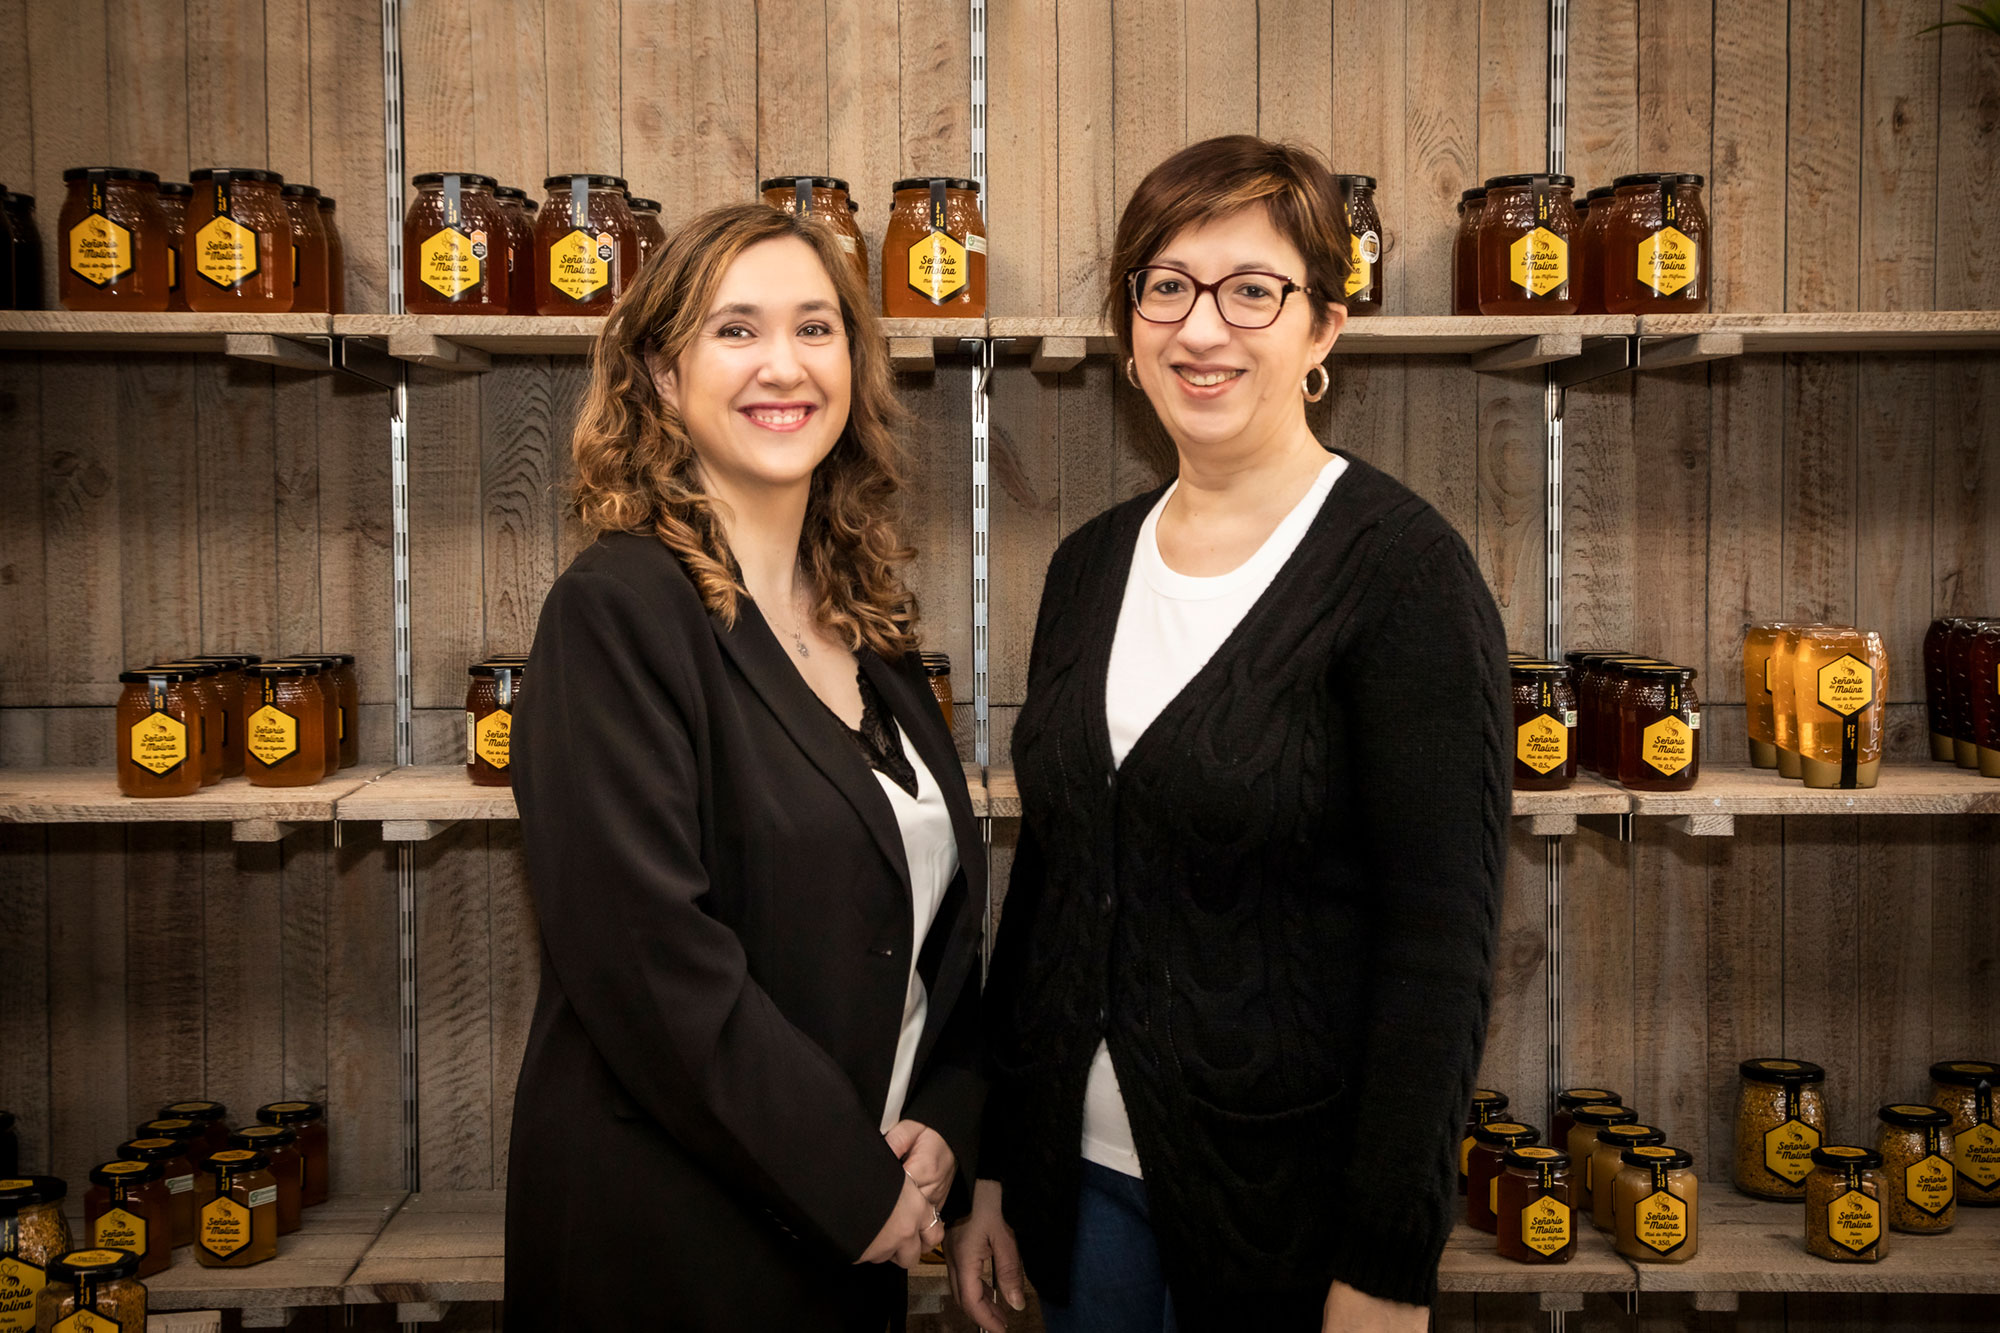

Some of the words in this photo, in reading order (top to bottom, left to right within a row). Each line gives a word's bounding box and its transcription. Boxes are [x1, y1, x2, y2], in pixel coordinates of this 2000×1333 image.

[432, 251, 469, 261] Señorío
[560, 254, 597, 264] Señorío
[920, 255, 956, 265] Señorío
[1523, 250, 1559, 261] Señorío
[1651, 250, 1687, 260] Señorío
[436, 262, 469, 272] Molina
[564, 264, 597, 275] Molina
[1527, 261, 1559, 271] Molina
[1654, 260, 1686, 270] Molina
[1831, 676, 1863, 685] Señorío
[1834, 685, 1863, 694] Molina
[142, 733, 177, 743] Señorío
[485, 729, 510, 739] Señor
[1528, 734, 1560, 743] Señorío
[488, 738, 510, 748] Molin
[1654, 736, 1685, 745] Señorío
[146, 743, 176, 752] Molina
[1531, 743, 1560, 752] Molina
[1657, 745, 1685, 754] Molina
[1777, 1141, 1811, 1151] Señorío
[1918, 1174, 1948, 1184] Señorío
[1921, 1184, 1948, 1192] Molina
[1645, 1211, 1679, 1220] Señorío
[1839, 1211, 1872, 1220] Señorío
[207, 1217, 240, 1226] Señorío
[1532, 1216, 1564, 1226] Señorío
[1649, 1221, 1679, 1230] Molina
[1843, 1220, 1873, 1229] Molina
[101, 1228, 136, 1239] Señorío
[211, 1226, 240, 1235] Molina
[1535, 1225, 1564, 1235] Molina
[104, 1238, 136, 1247] Molina
[0, 1285, 33, 1300] ñorío
[0, 1300, 33, 1314] olina
